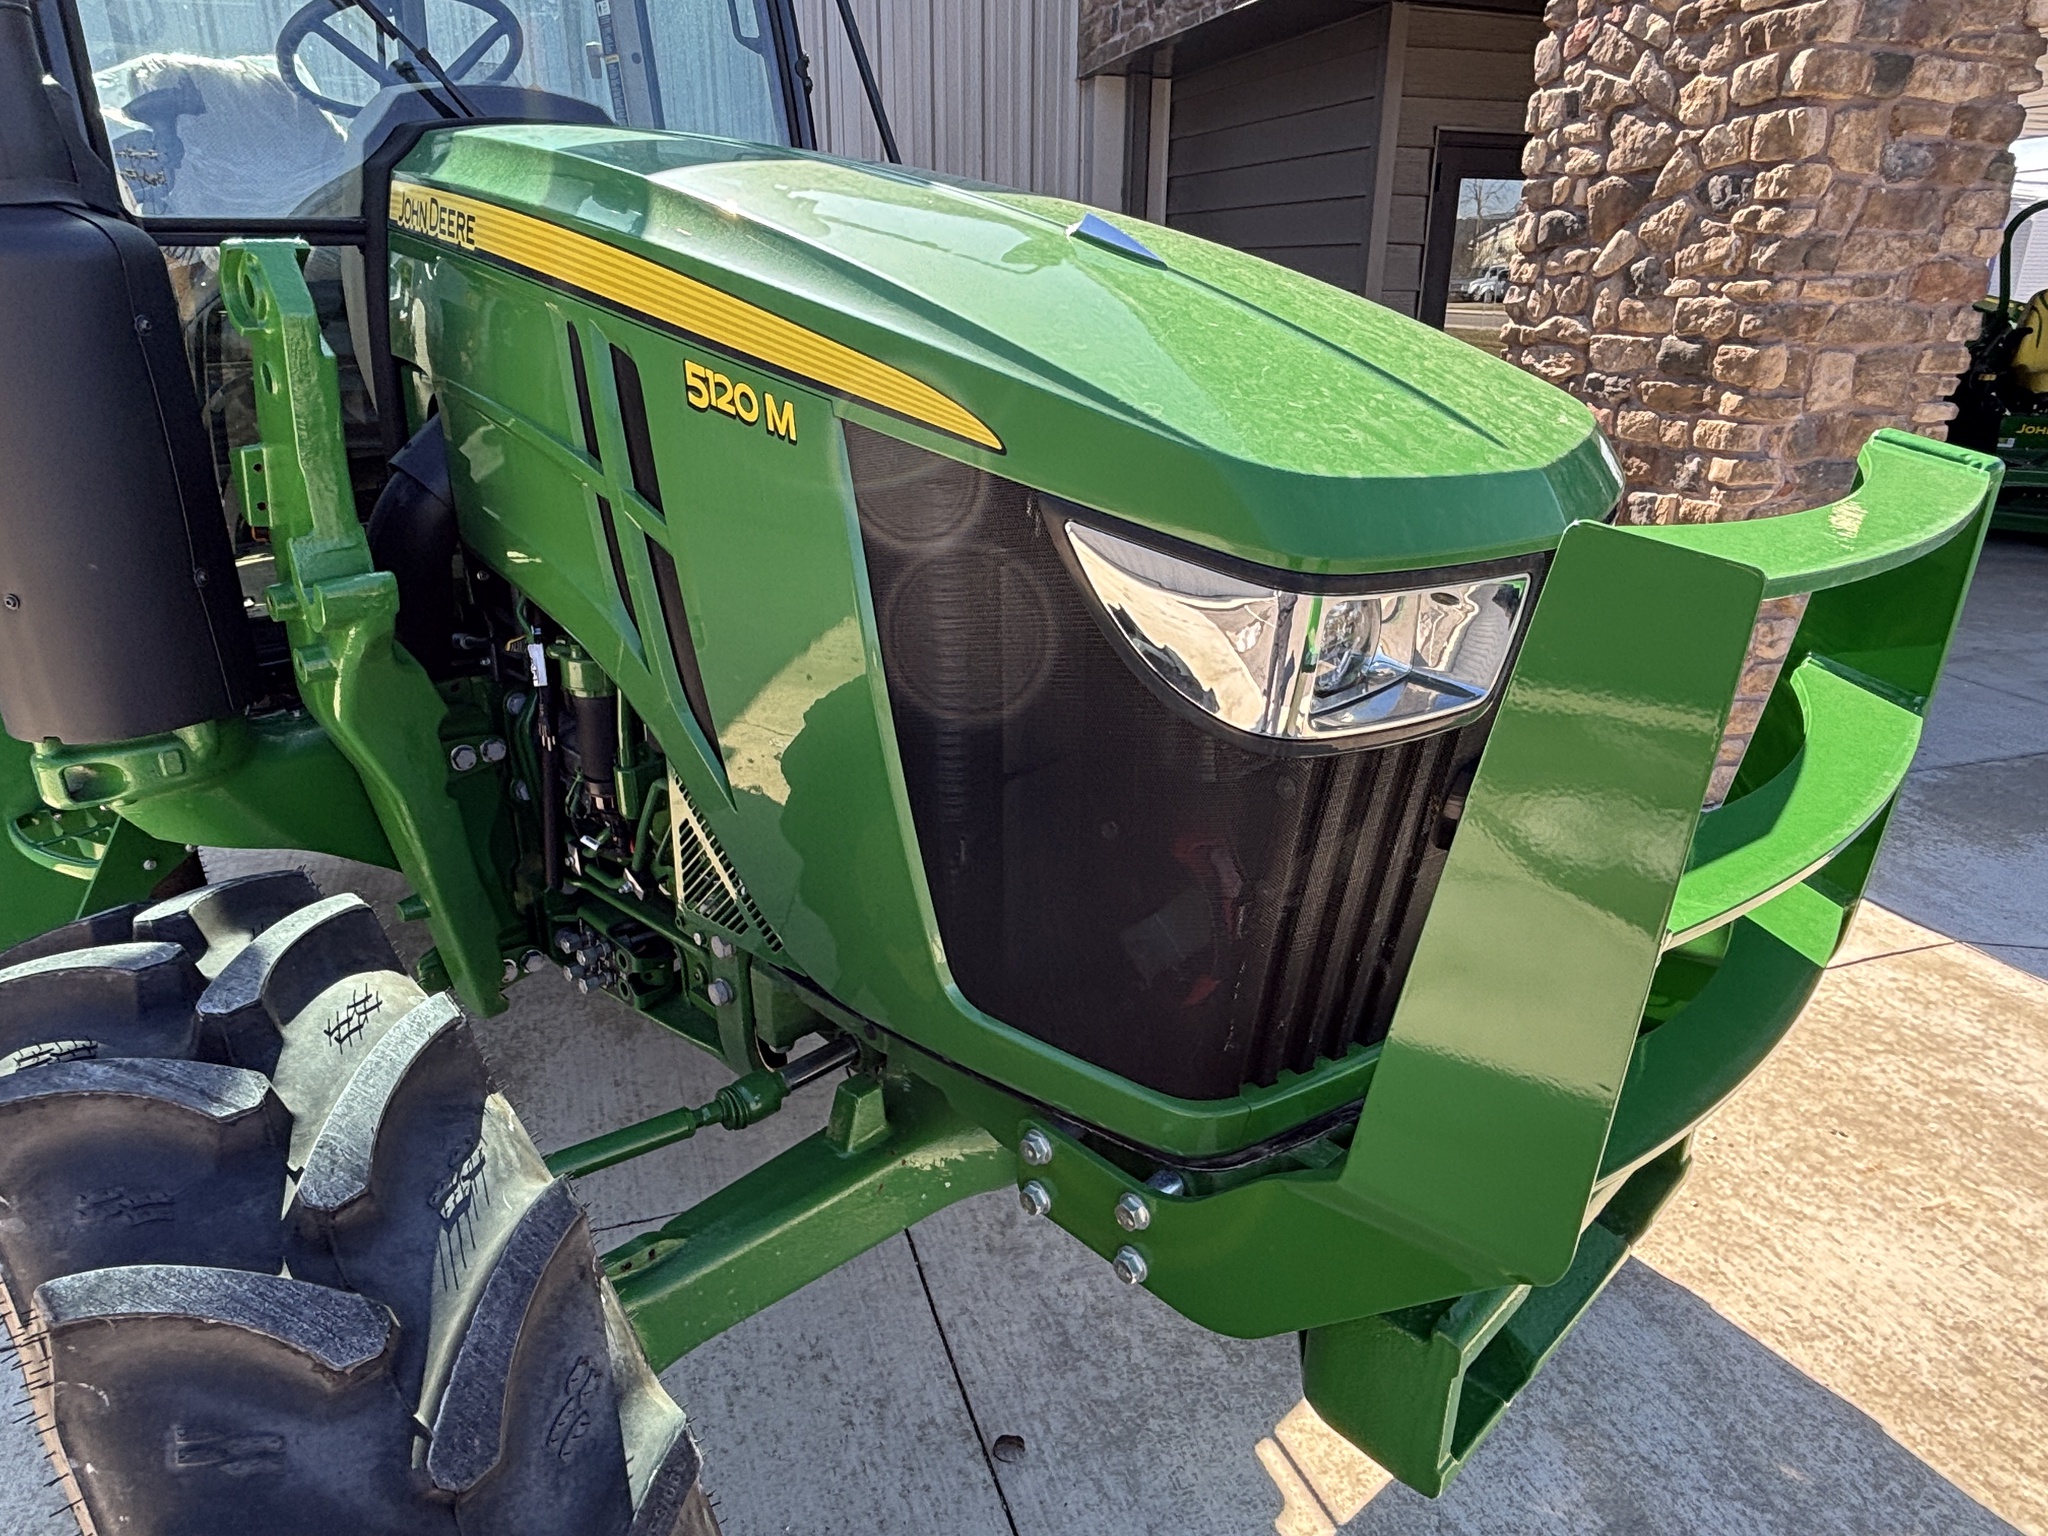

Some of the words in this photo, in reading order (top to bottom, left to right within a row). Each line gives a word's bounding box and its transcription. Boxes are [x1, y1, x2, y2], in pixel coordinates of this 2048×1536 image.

[398, 191, 428, 230] JOHN
[429, 197, 476, 246] DEERE
[684, 359, 759, 424] 5120
[764, 391, 798, 444] M
[2016, 423, 2048, 435] JOH
